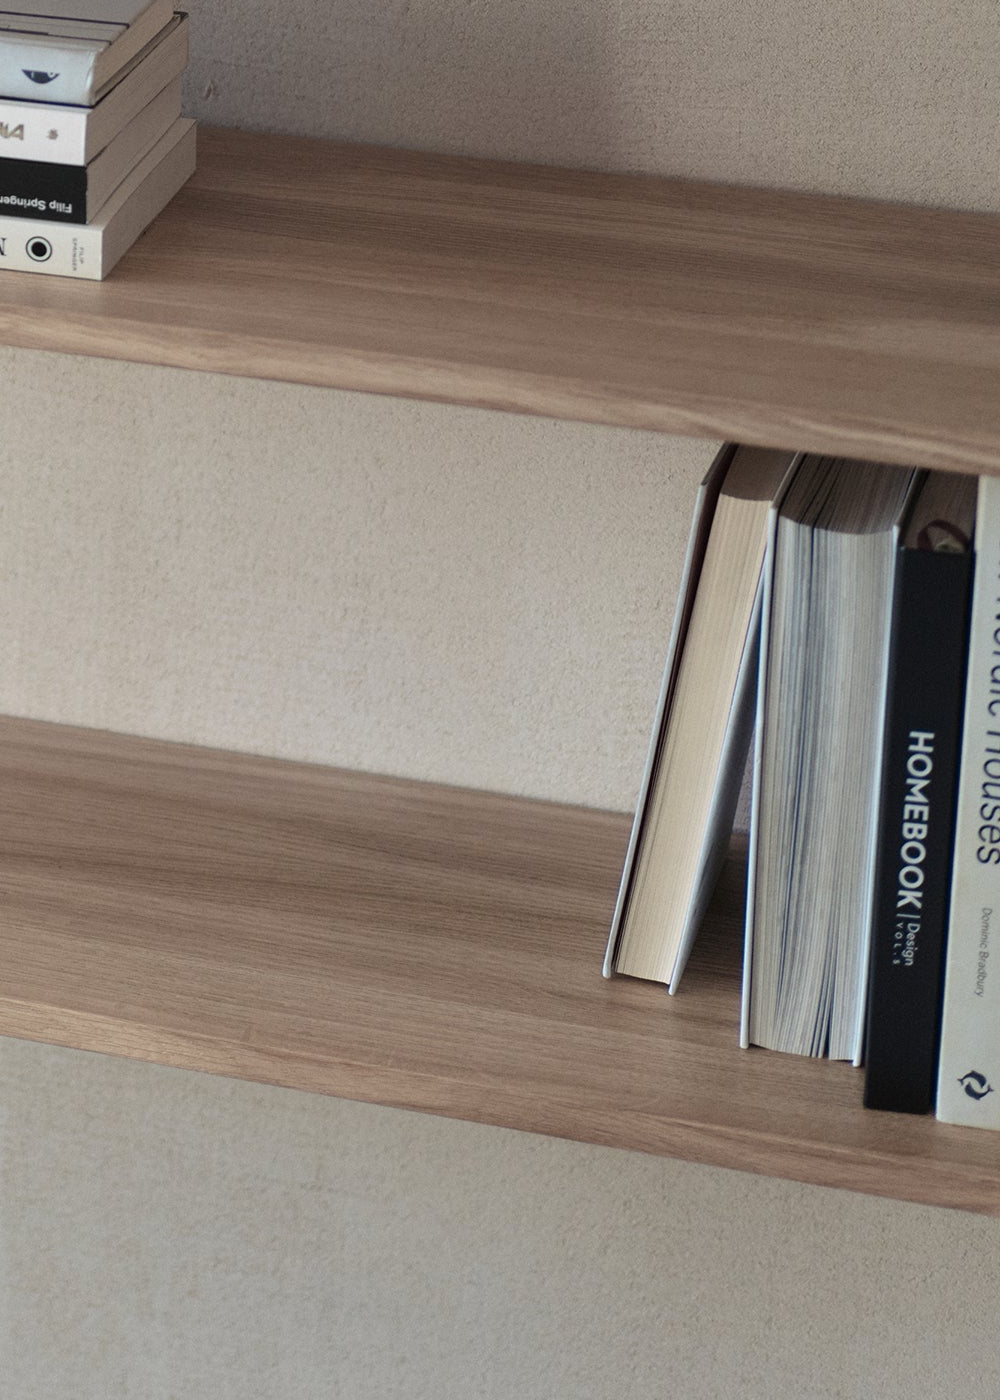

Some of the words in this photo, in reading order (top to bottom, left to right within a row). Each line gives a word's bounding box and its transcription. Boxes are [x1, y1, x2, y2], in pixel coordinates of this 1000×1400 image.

[48, 201, 73, 214] Filip
[895, 730, 935, 910] HOMEBOOK
[901, 922, 921, 967] Design
[978, 906, 993, 949] Dominic
[973, 950, 990, 998] Bradbury
